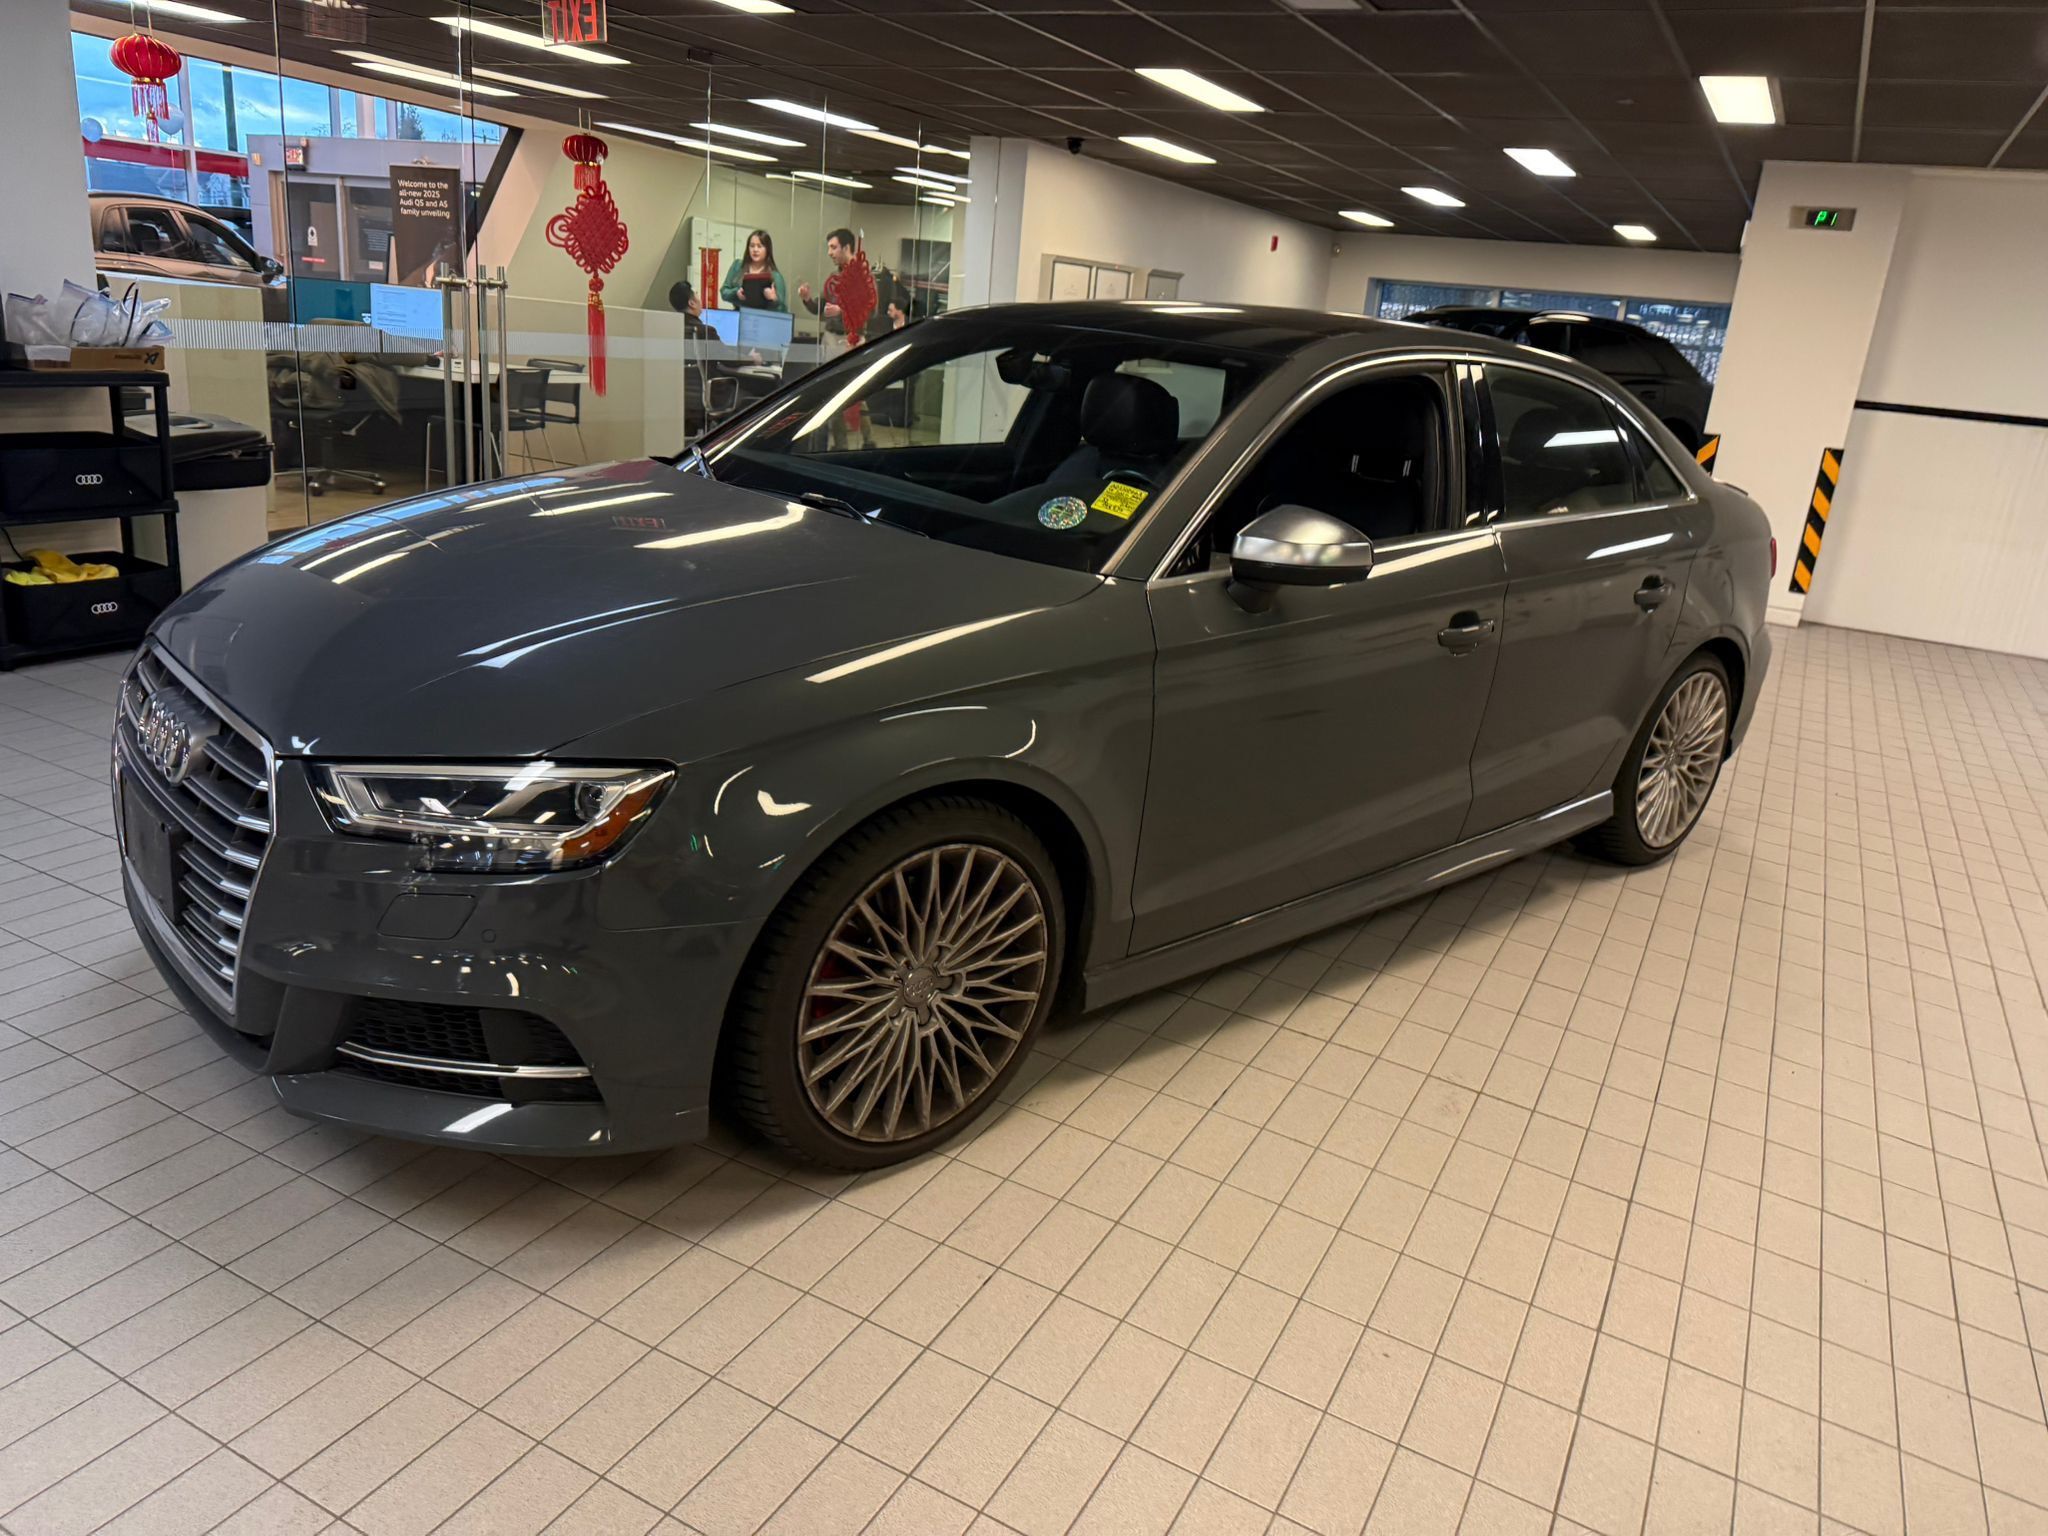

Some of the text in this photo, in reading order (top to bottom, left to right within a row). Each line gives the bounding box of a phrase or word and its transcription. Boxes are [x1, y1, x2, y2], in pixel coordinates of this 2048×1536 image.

[398, 180, 428, 188] Welcome
[438, 182, 448, 190] the
[399, 190, 440, 198] all-new 2025
[400, 198, 414, 206] Audi
[400, 208, 450, 219] family unveiling
